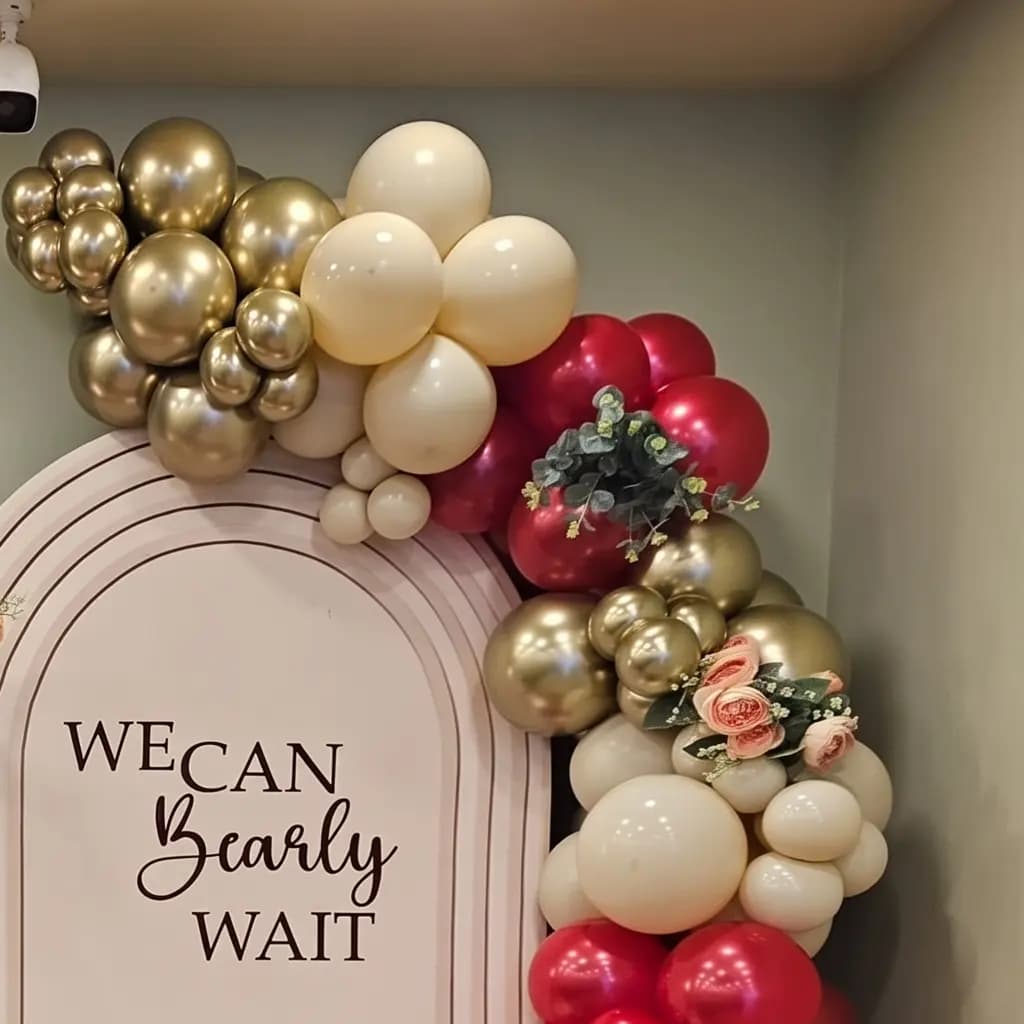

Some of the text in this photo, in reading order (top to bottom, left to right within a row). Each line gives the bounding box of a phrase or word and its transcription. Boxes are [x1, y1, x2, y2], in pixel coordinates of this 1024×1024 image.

[63, 720, 344, 794] WE CAN
[136, 793, 398, 907] Bearly
[191, 911, 376, 961] WAIT
